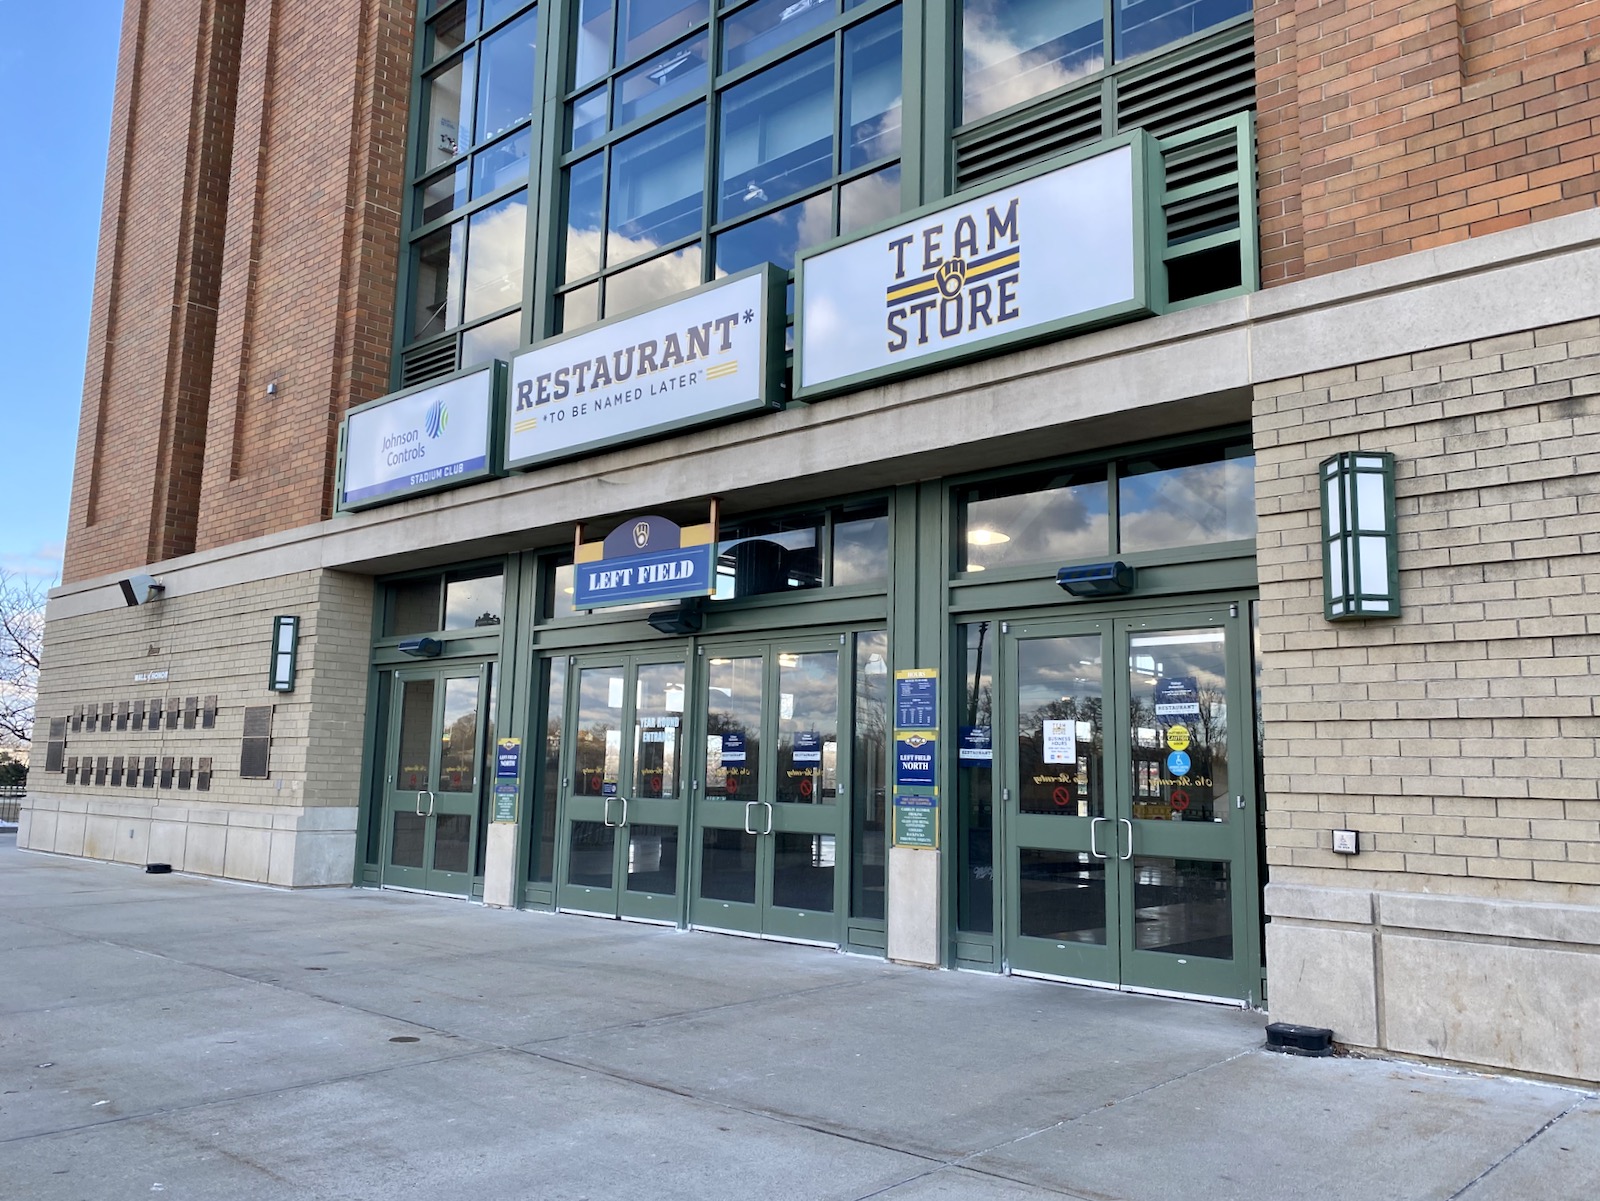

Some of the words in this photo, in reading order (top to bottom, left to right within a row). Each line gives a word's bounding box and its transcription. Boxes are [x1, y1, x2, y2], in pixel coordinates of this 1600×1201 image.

[888, 198, 1019, 280] TEAM
[887, 273, 1019, 352] STORE
[572, 403, 587, 417] BE
[594, 388, 643, 412] NAMED
[650, 371, 698, 396] LATER
[382, 429, 419, 453] Johnson
[387, 443, 425, 467] Controls
[410, 469, 442, 485] STADIUM
[444, 463, 464, 477] CLUB
[588, 568, 633, 591] LEFT
[637, 560, 694, 585] FIELD
[640, 717, 656, 728] YEAR
[657, 716, 680, 728] ROUND
[642, 731, 676, 743] ENTRANCE
[902, 762, 929, 770] NORTH
